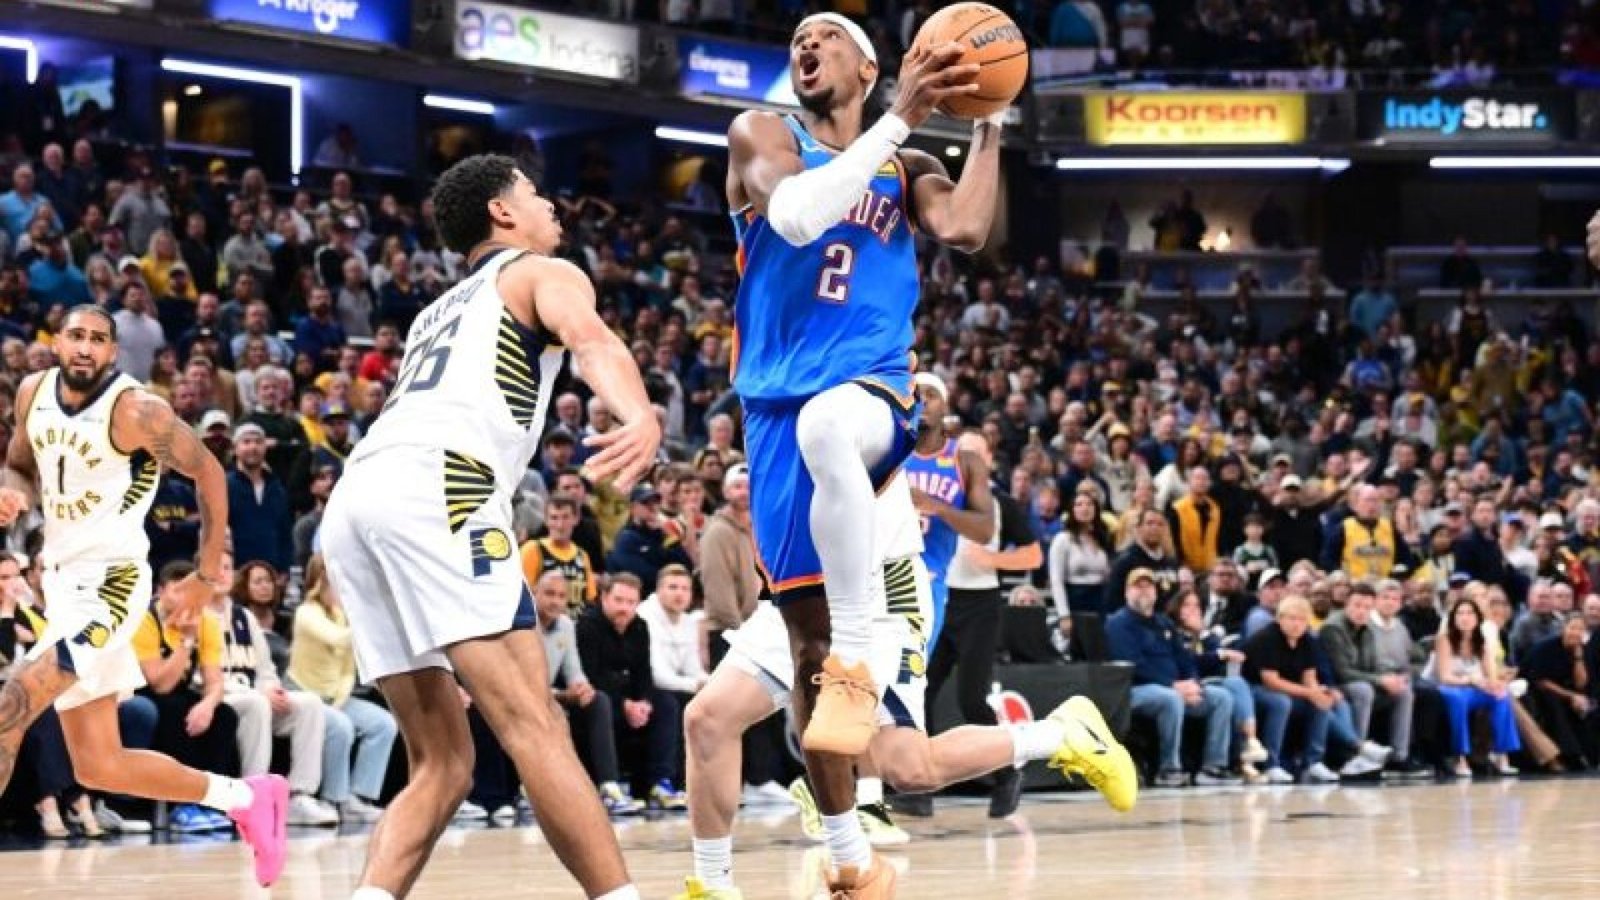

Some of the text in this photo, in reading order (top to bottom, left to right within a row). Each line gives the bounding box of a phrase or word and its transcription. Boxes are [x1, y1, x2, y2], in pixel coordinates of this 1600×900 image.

[461, 8, 541, 57] aes
[1106, 96, 1278, 122] Koorsen
[1385, 98, 1548, 134] IndyStar.
[817, 243, 853, 302] 2
[33, 427, 103, 470] NDIANA
[57, 455, 67, 495] 1
